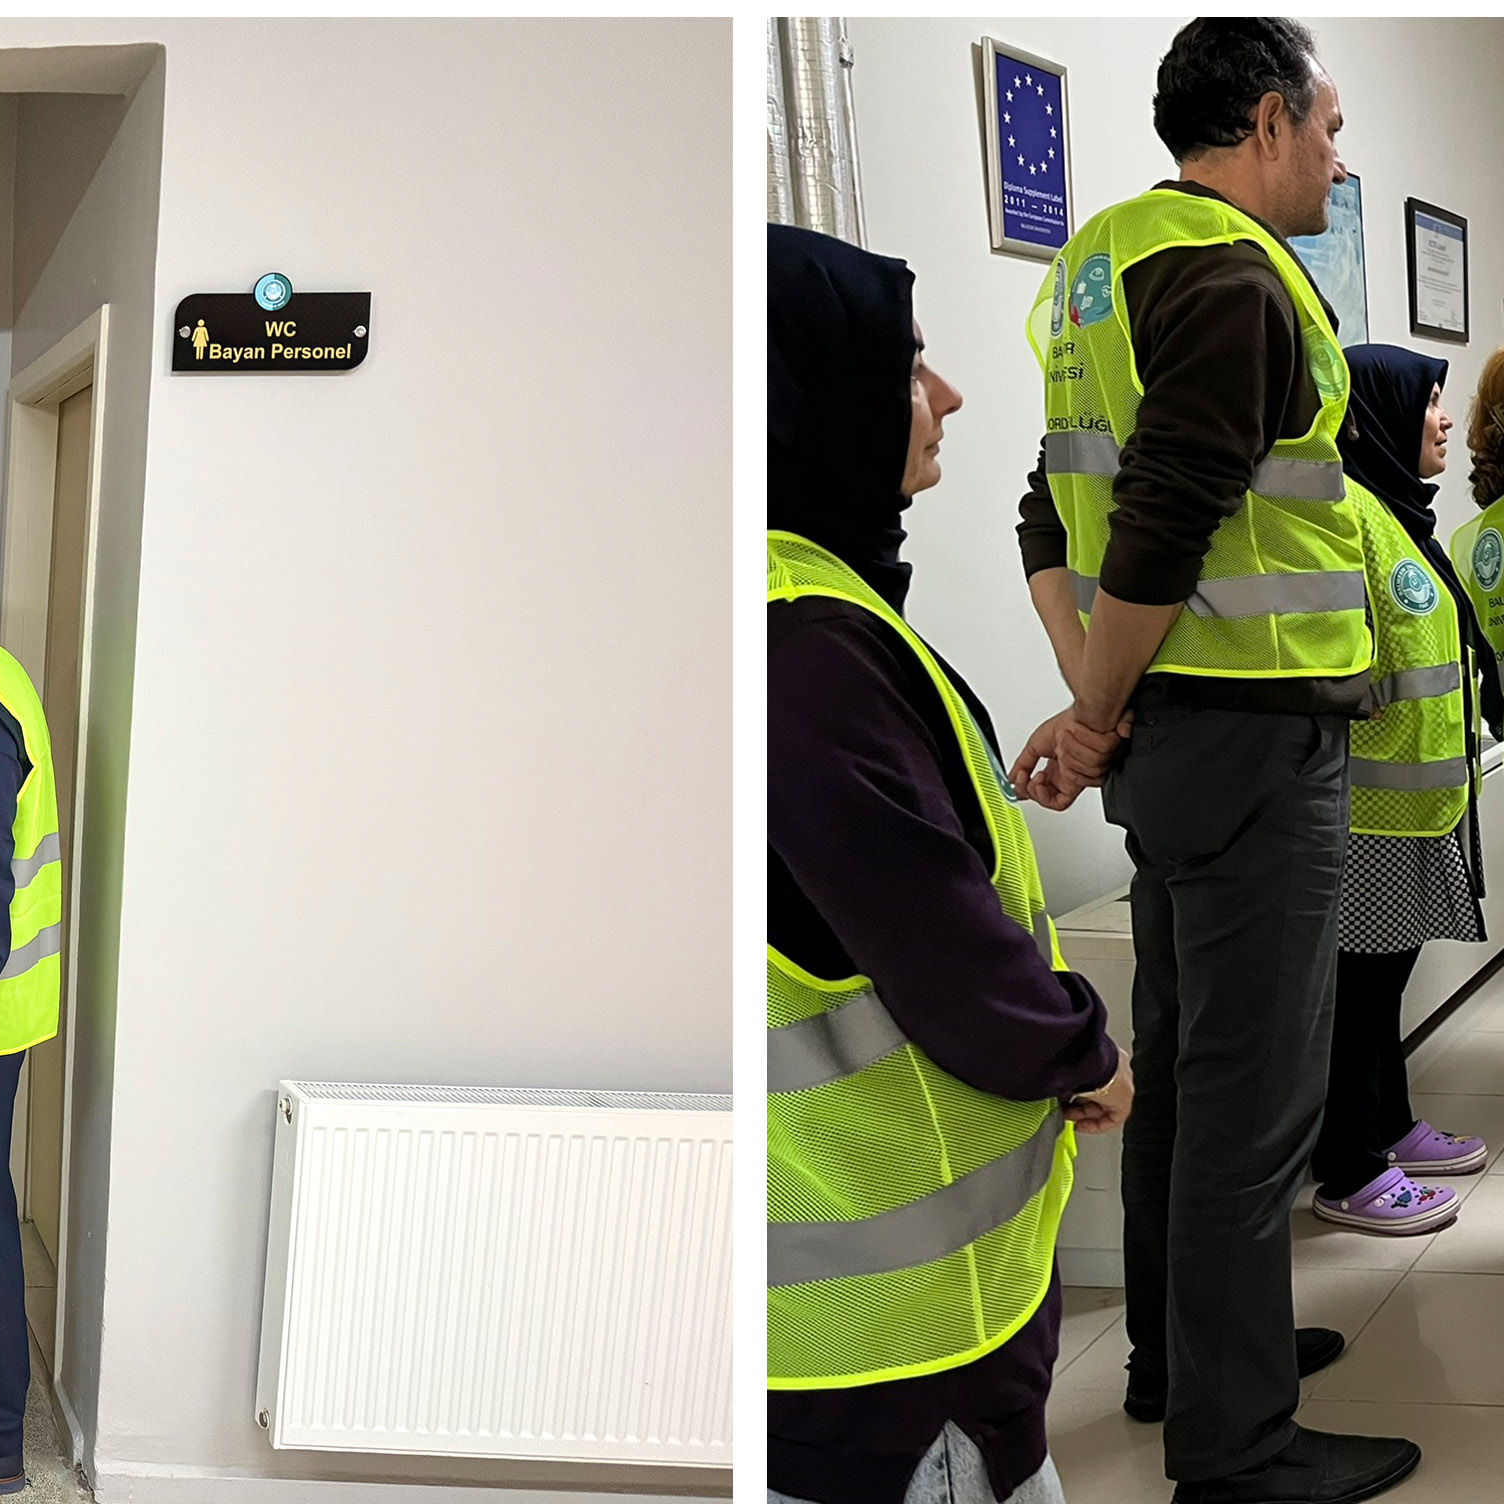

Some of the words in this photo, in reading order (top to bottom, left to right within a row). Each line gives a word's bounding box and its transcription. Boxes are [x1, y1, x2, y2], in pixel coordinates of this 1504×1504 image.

[1004, 194, 1026, 208] 2011
[1043, 204, 1064, 216] 2014
[265, 321, 297, 337] WC
[209, 343, 265, 363] Bayan
[271, 342, 352, 360] Personel
